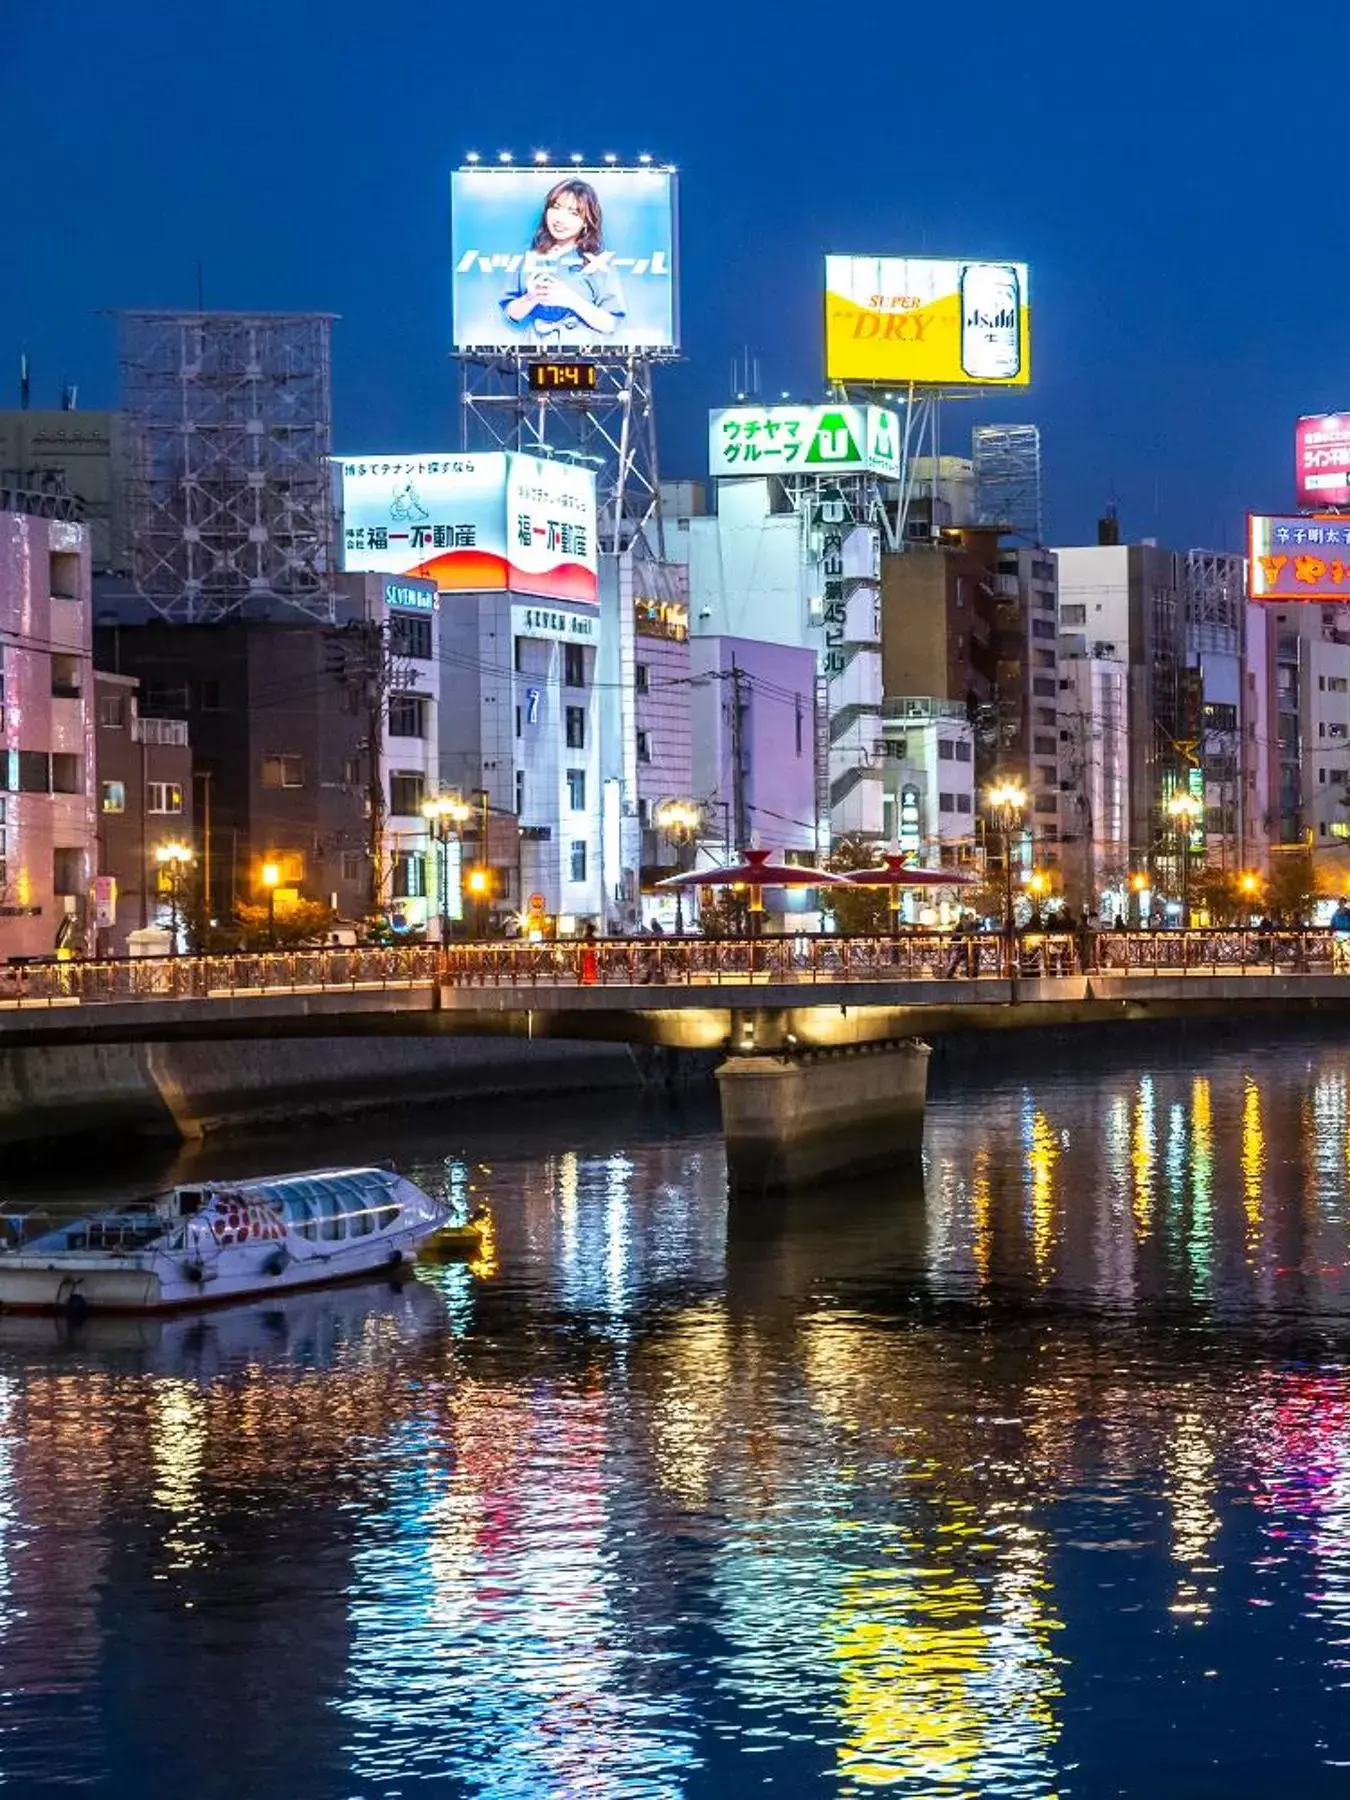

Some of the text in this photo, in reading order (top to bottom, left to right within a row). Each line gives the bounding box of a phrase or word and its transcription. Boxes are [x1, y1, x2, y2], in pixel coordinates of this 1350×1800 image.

[868, 294, 921, 308] SUPER
[537, 365, 596, 385] 17:41
[723, 419, 801, 441] ウチヤマ
[723, 441, 803, 464] グループ
[367, 524, 476, 550] 福一不動産
[517, 512, 588, 557] 福一不動産
[525, 610, 565, 630] SEVEN
